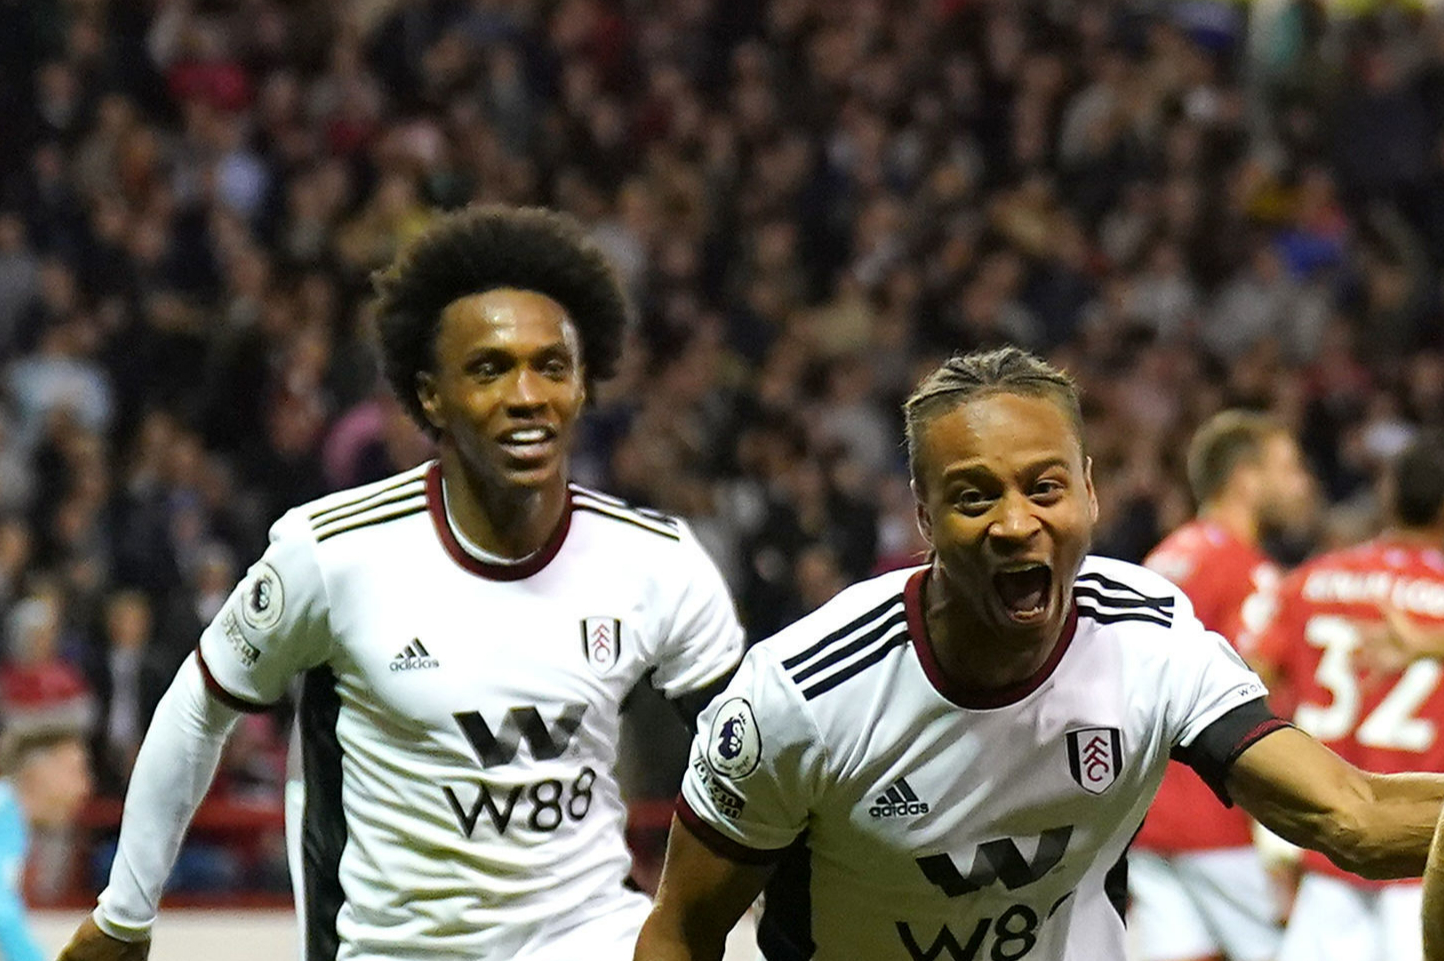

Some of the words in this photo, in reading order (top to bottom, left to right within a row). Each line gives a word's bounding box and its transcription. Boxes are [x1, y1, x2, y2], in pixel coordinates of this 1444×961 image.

[389, 657, 440, 672] adidas
[1293, 613, 1444, 753] 32
[440, 766, 596, 839] W88
[869, 802, 930, 818] adidas
